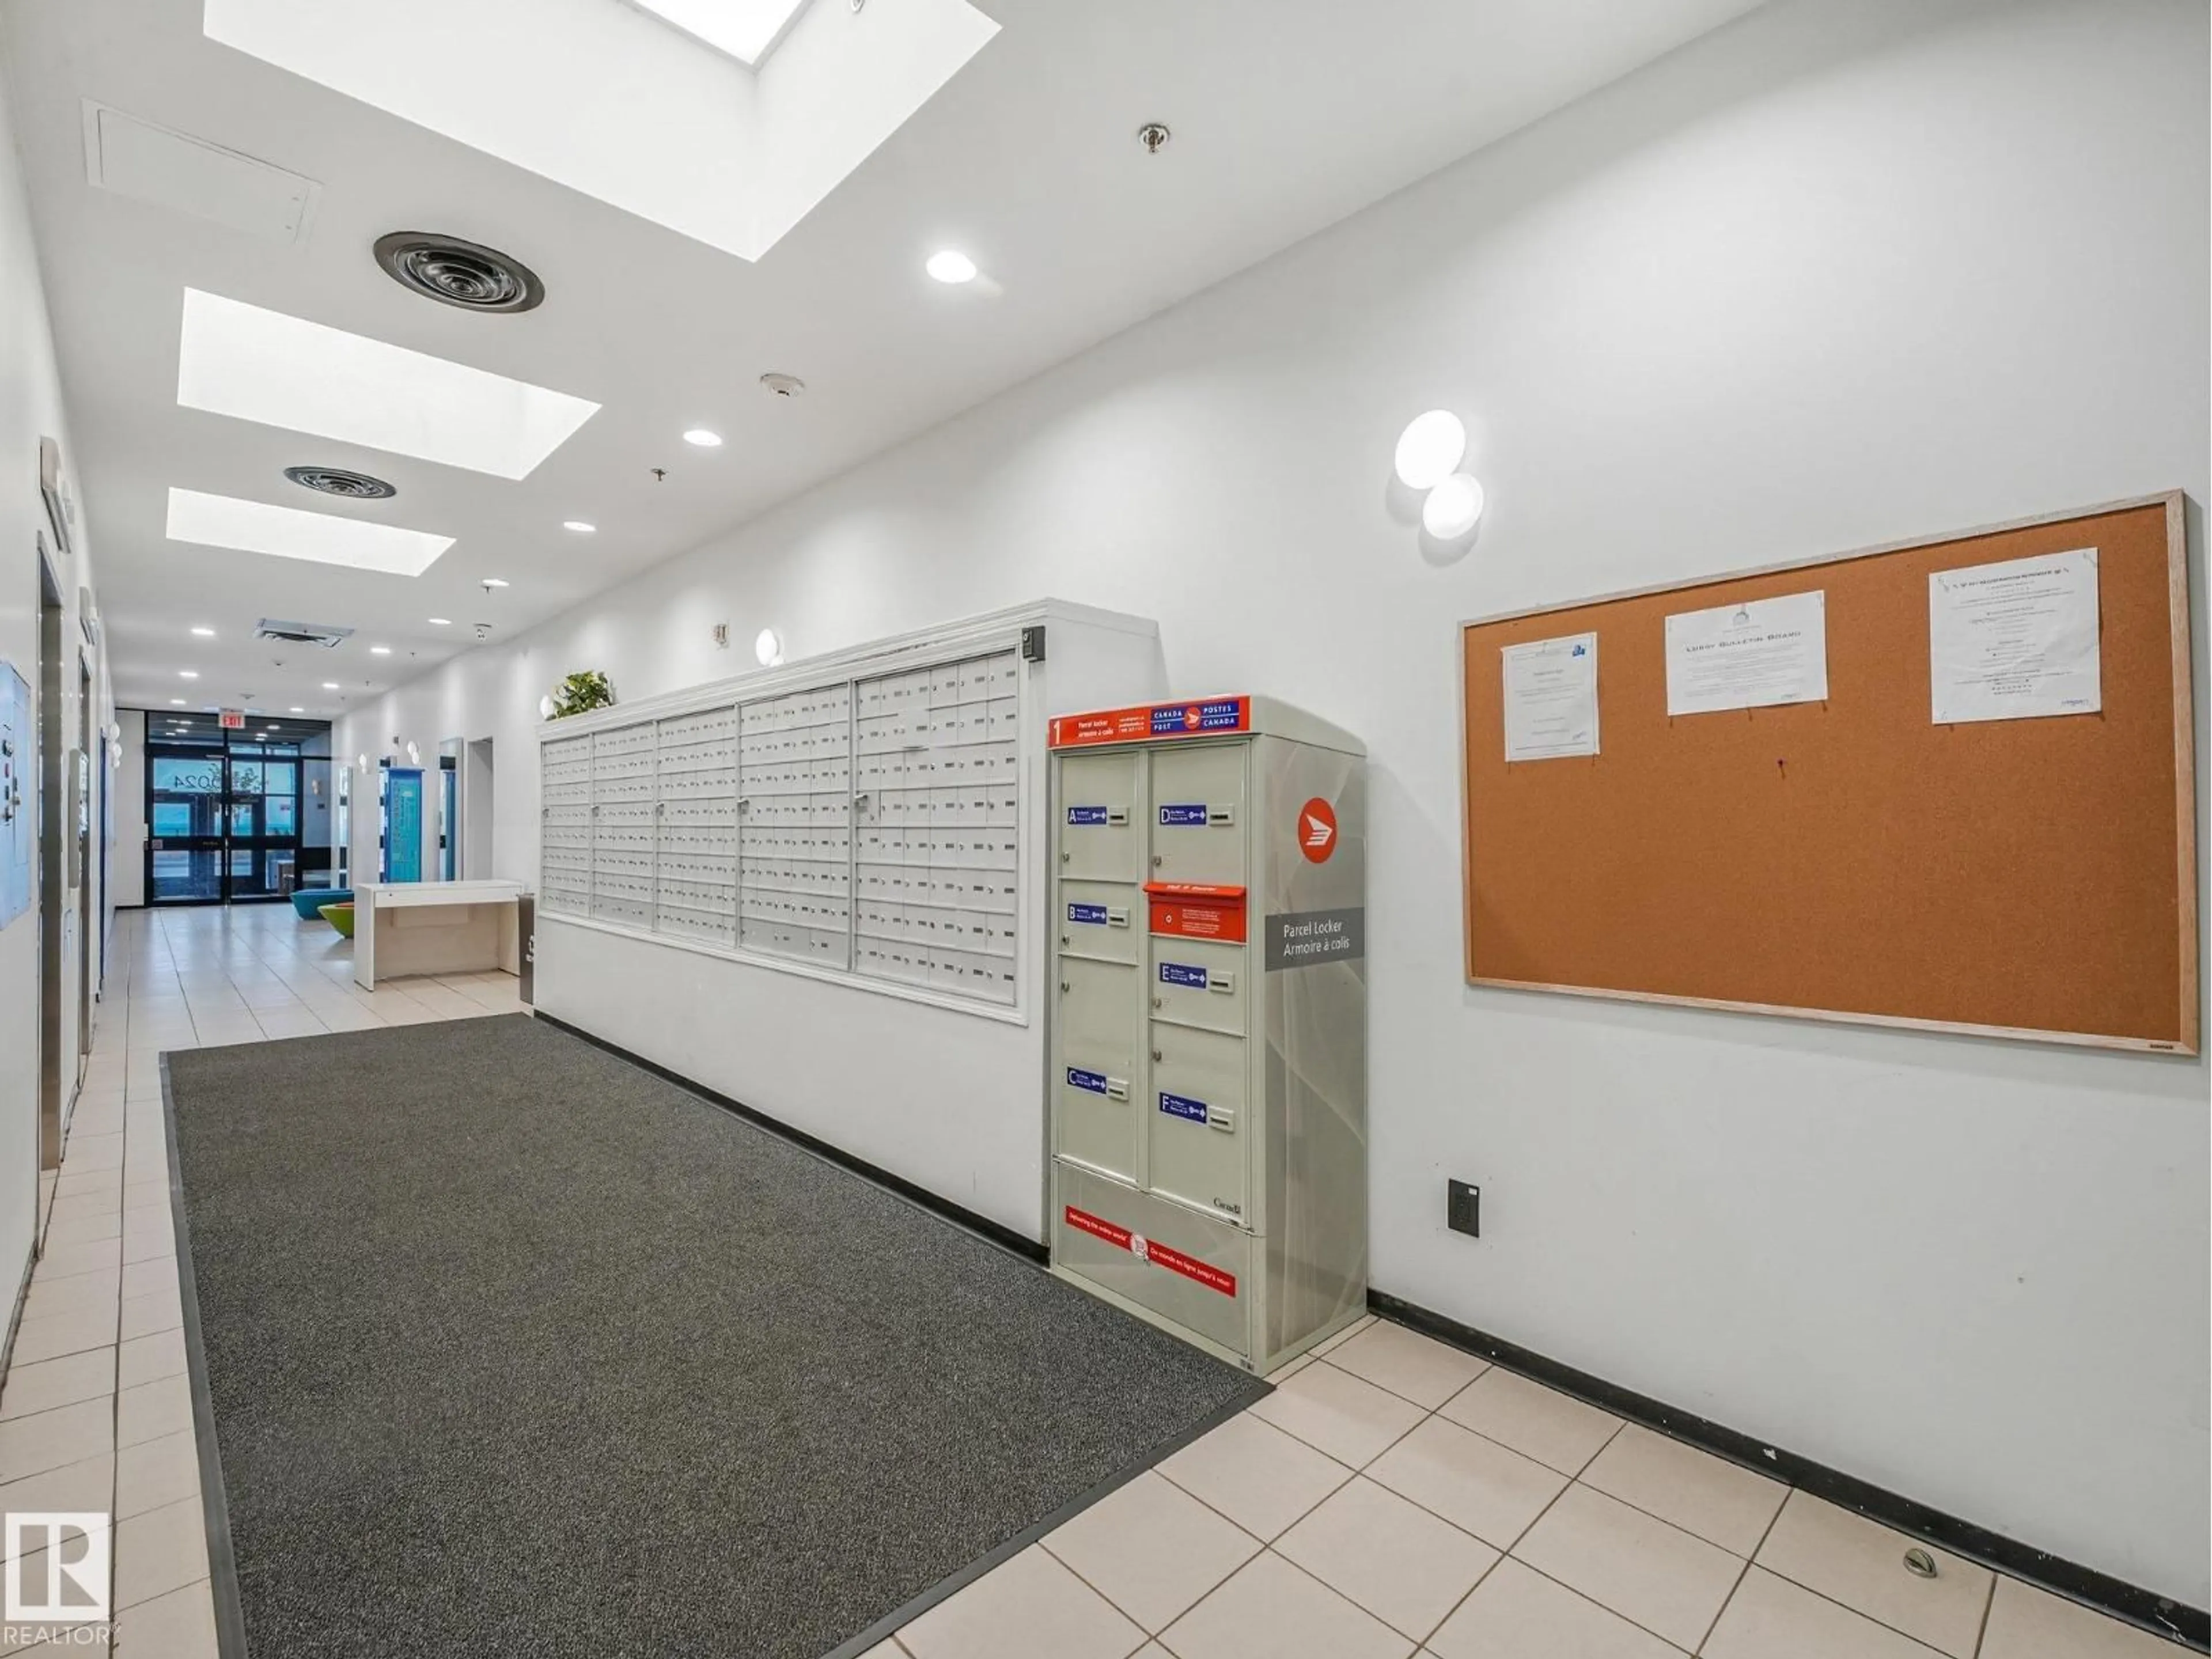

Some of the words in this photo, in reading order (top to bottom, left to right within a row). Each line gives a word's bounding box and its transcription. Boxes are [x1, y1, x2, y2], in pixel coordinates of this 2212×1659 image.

[1154, 710, 1182, 718] CANADA
[1204, 704, 1232, 713] POSTES
[223, 715, 241, 726] EXIT
[1154, 722, 1172, 730] POST
[1204, 717, 1234, 726] CANADA
[1053, 720, 1060, 745] 1
[1069, 809, 1076, 823] A
[1161, 808, 1170, 823] D
[1070, 906, 1075, 919] B
[1283, 921, 1312, 938] Parcel
[1314, 919, 1342, 934] Locker
[1283, 940, 1322, 956] Armoire
[1323, 938, 1330, 950] à
[1331, 936, 1350, 949] colis
[1162, 966, 1169, 980] E
[1069, 1070, 1076, 1084] C
[1162, 1095, 1169, 1110] F
